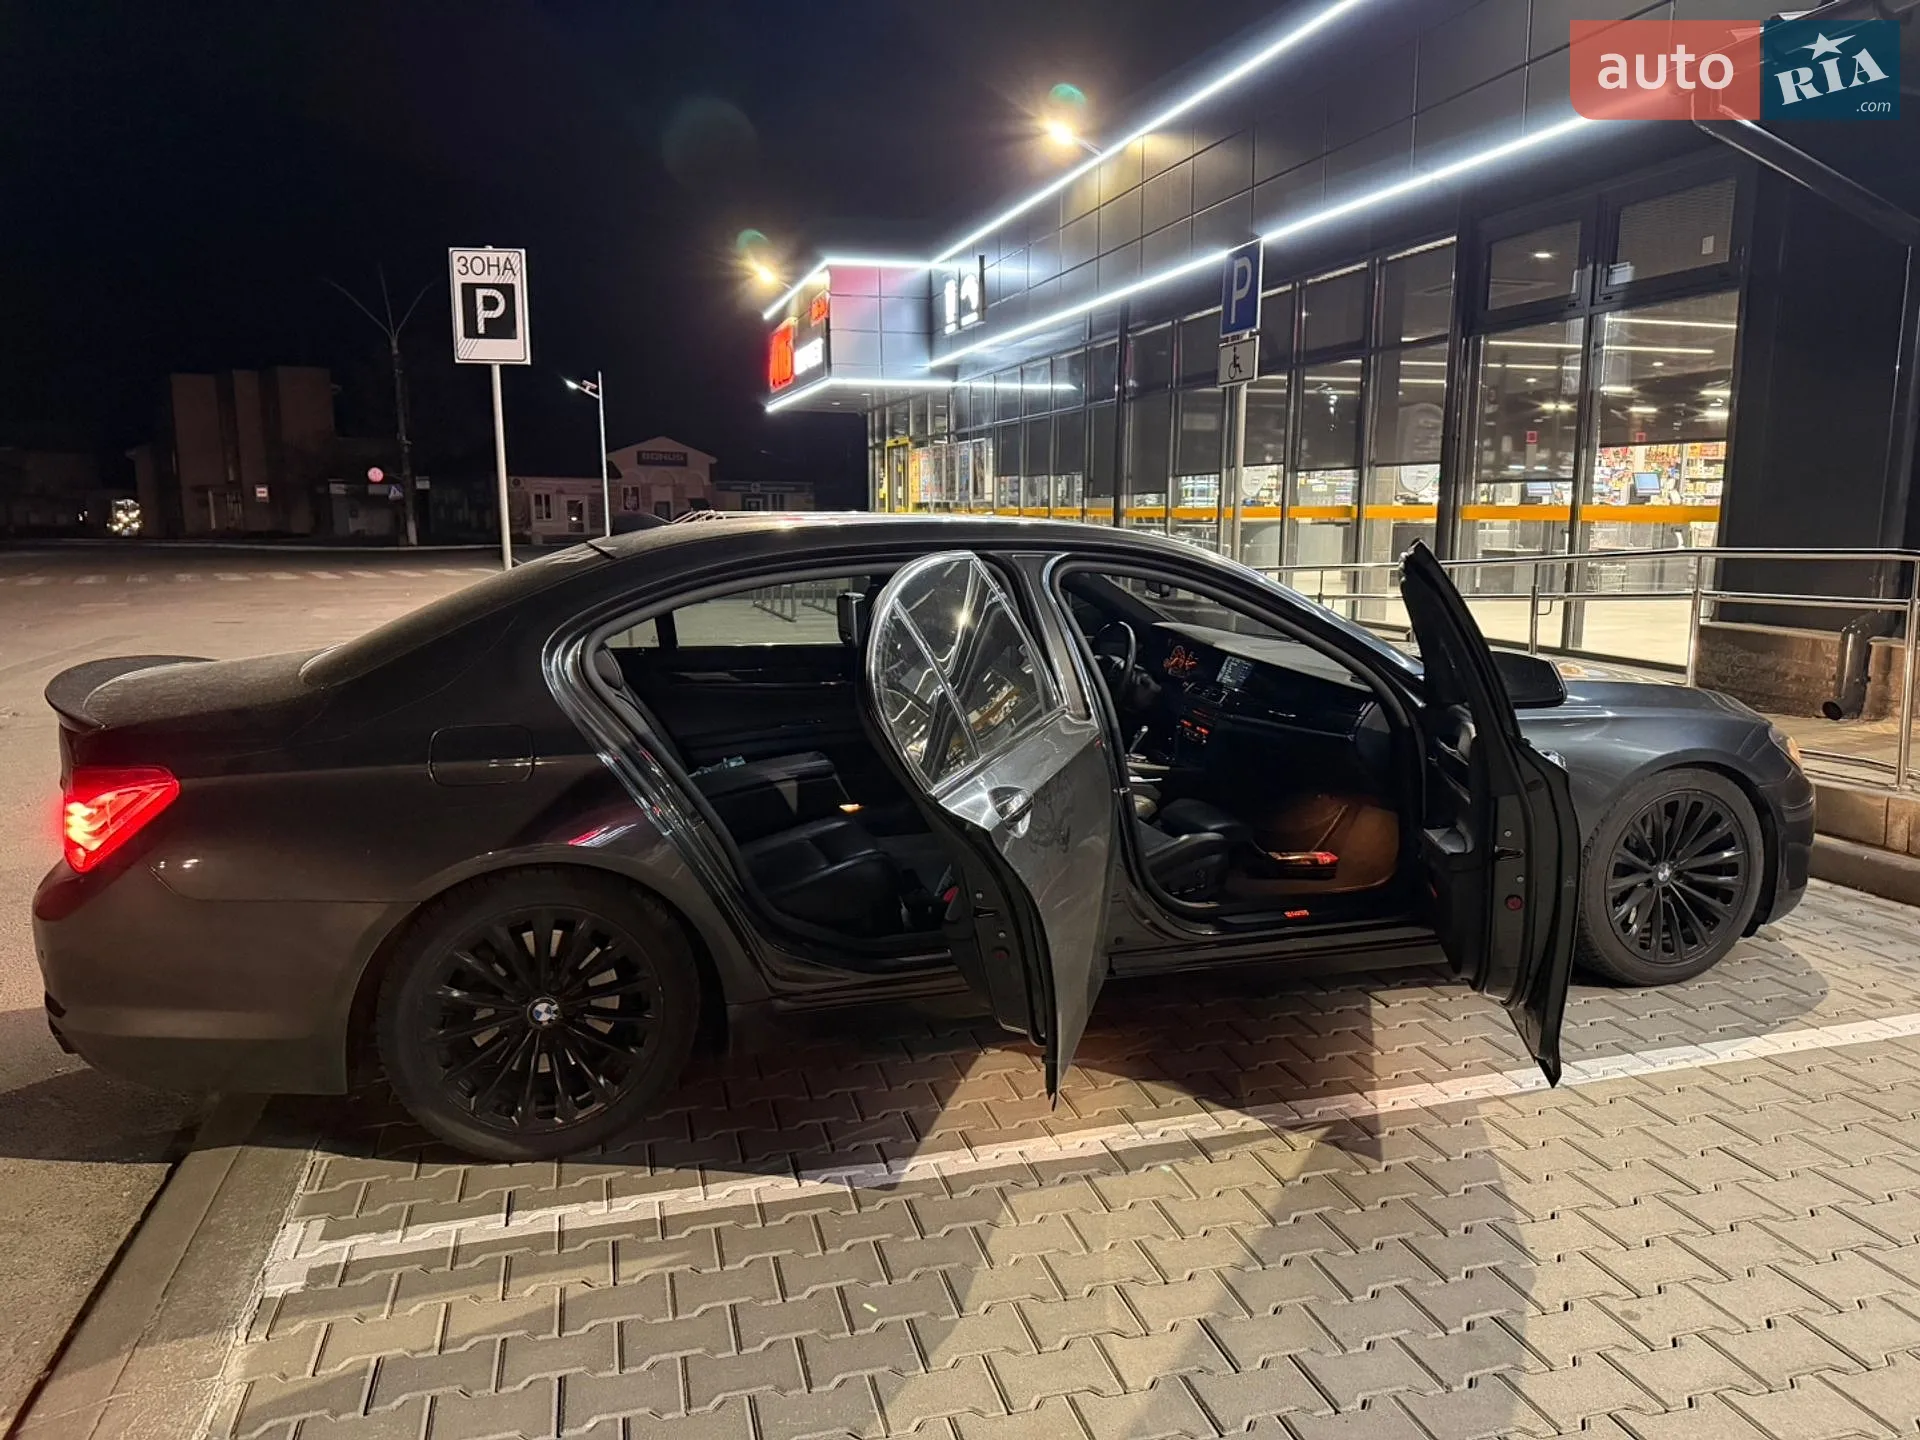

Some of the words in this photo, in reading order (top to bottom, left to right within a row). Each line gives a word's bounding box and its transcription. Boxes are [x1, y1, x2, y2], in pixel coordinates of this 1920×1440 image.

[457, 255, 517, 277] ЗОНА
[475, 287, 506, 334] P
[1230, 256, 1252, 325] P
